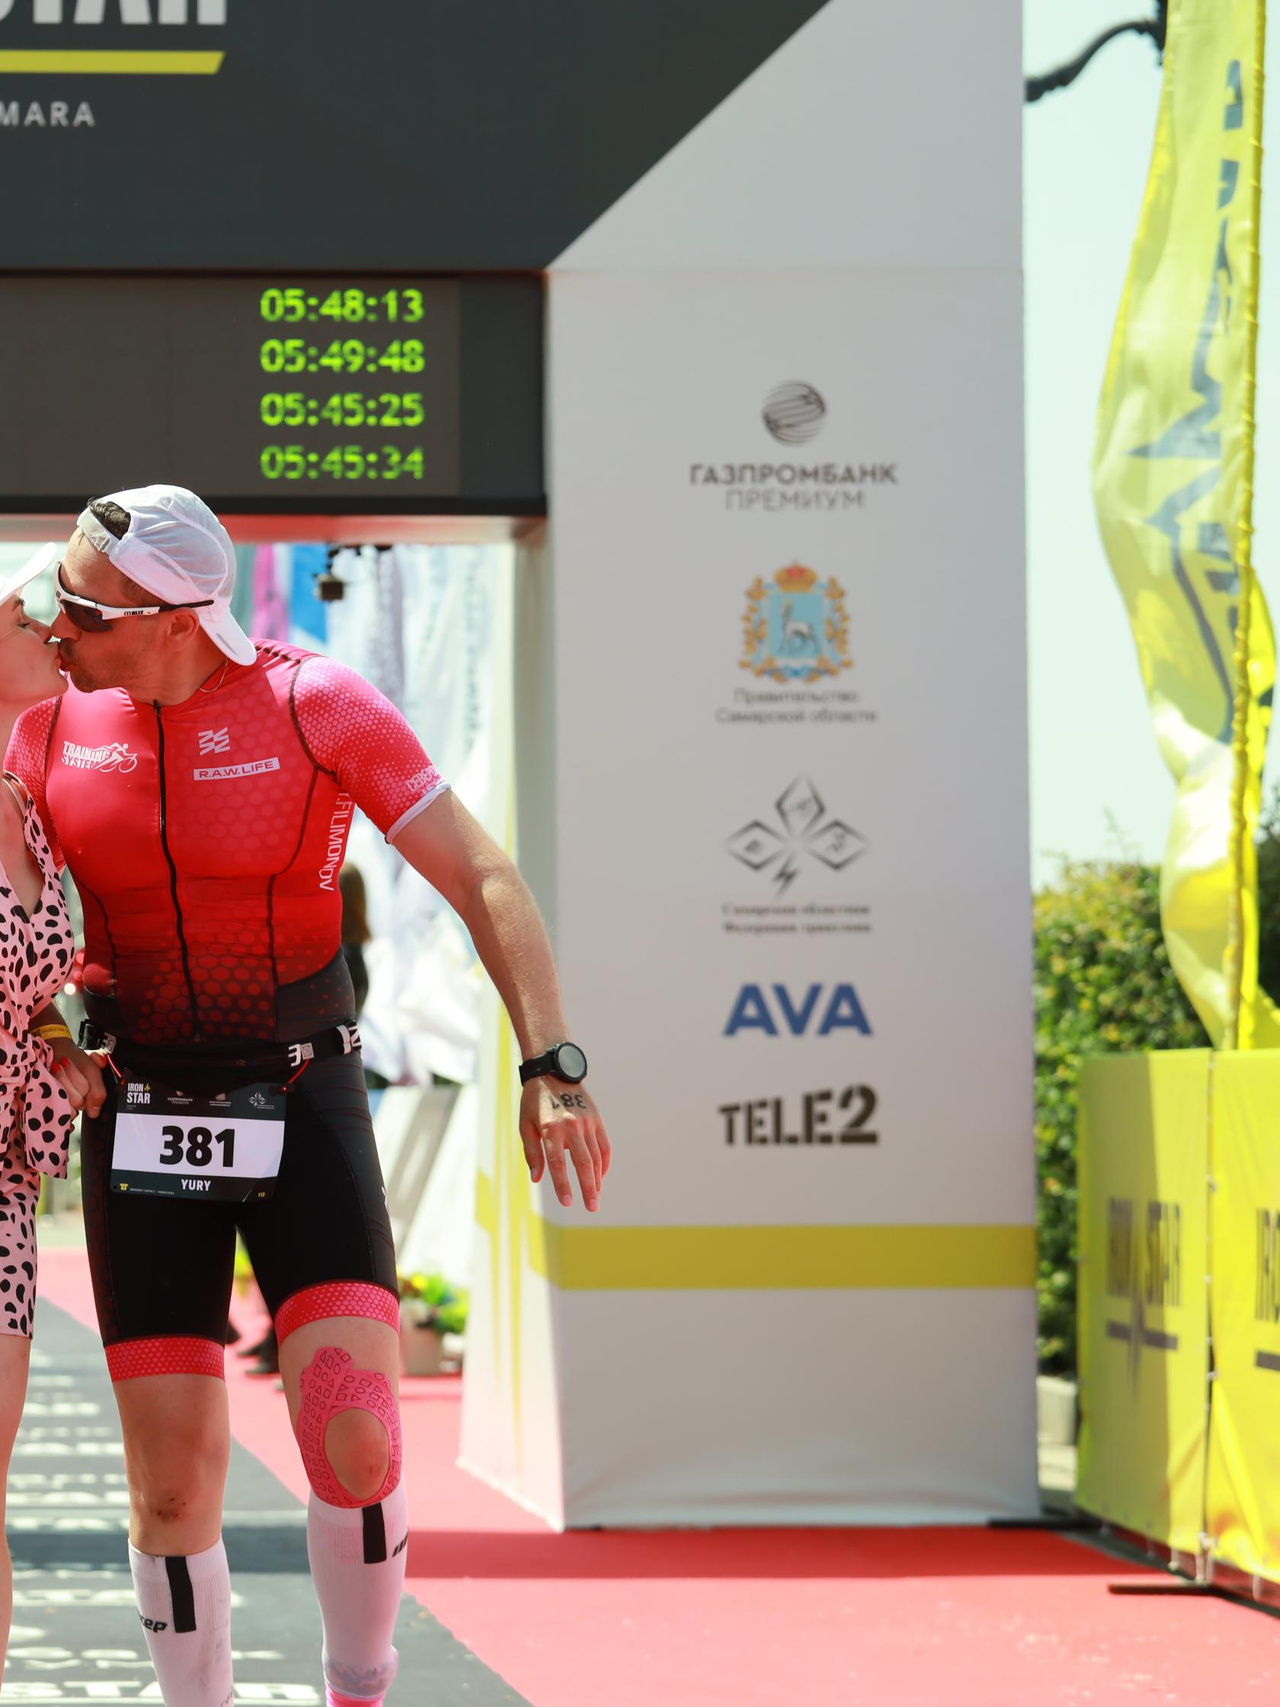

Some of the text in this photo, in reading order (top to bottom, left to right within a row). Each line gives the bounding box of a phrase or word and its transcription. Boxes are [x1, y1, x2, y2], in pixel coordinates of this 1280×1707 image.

[260, 288, 425, 323] 05:48:13
[260, 339, 426, 373] 05:49:48
[260, 392, 426, 427] 05:45:25
[260, 445, 425, 480] 05:45:34
[689, 463, 899, 486] ГАЗПРОМБАНК
[724, 488, 866, 512] ПРЕМИУМ
[62, 740, 111, 761] TRAINING
[242, 760, 274, 774] LIFE
[722, 983, 874, 1037] AVA
[126, 1092, 151, 1104] STAR
[127, 1083, 144, 1092] IRON
[718, 1083, 879, 1146] TELE2
[159, 1125, 236, 1168] 381
[180, 1178, 212, 1192] YURY
